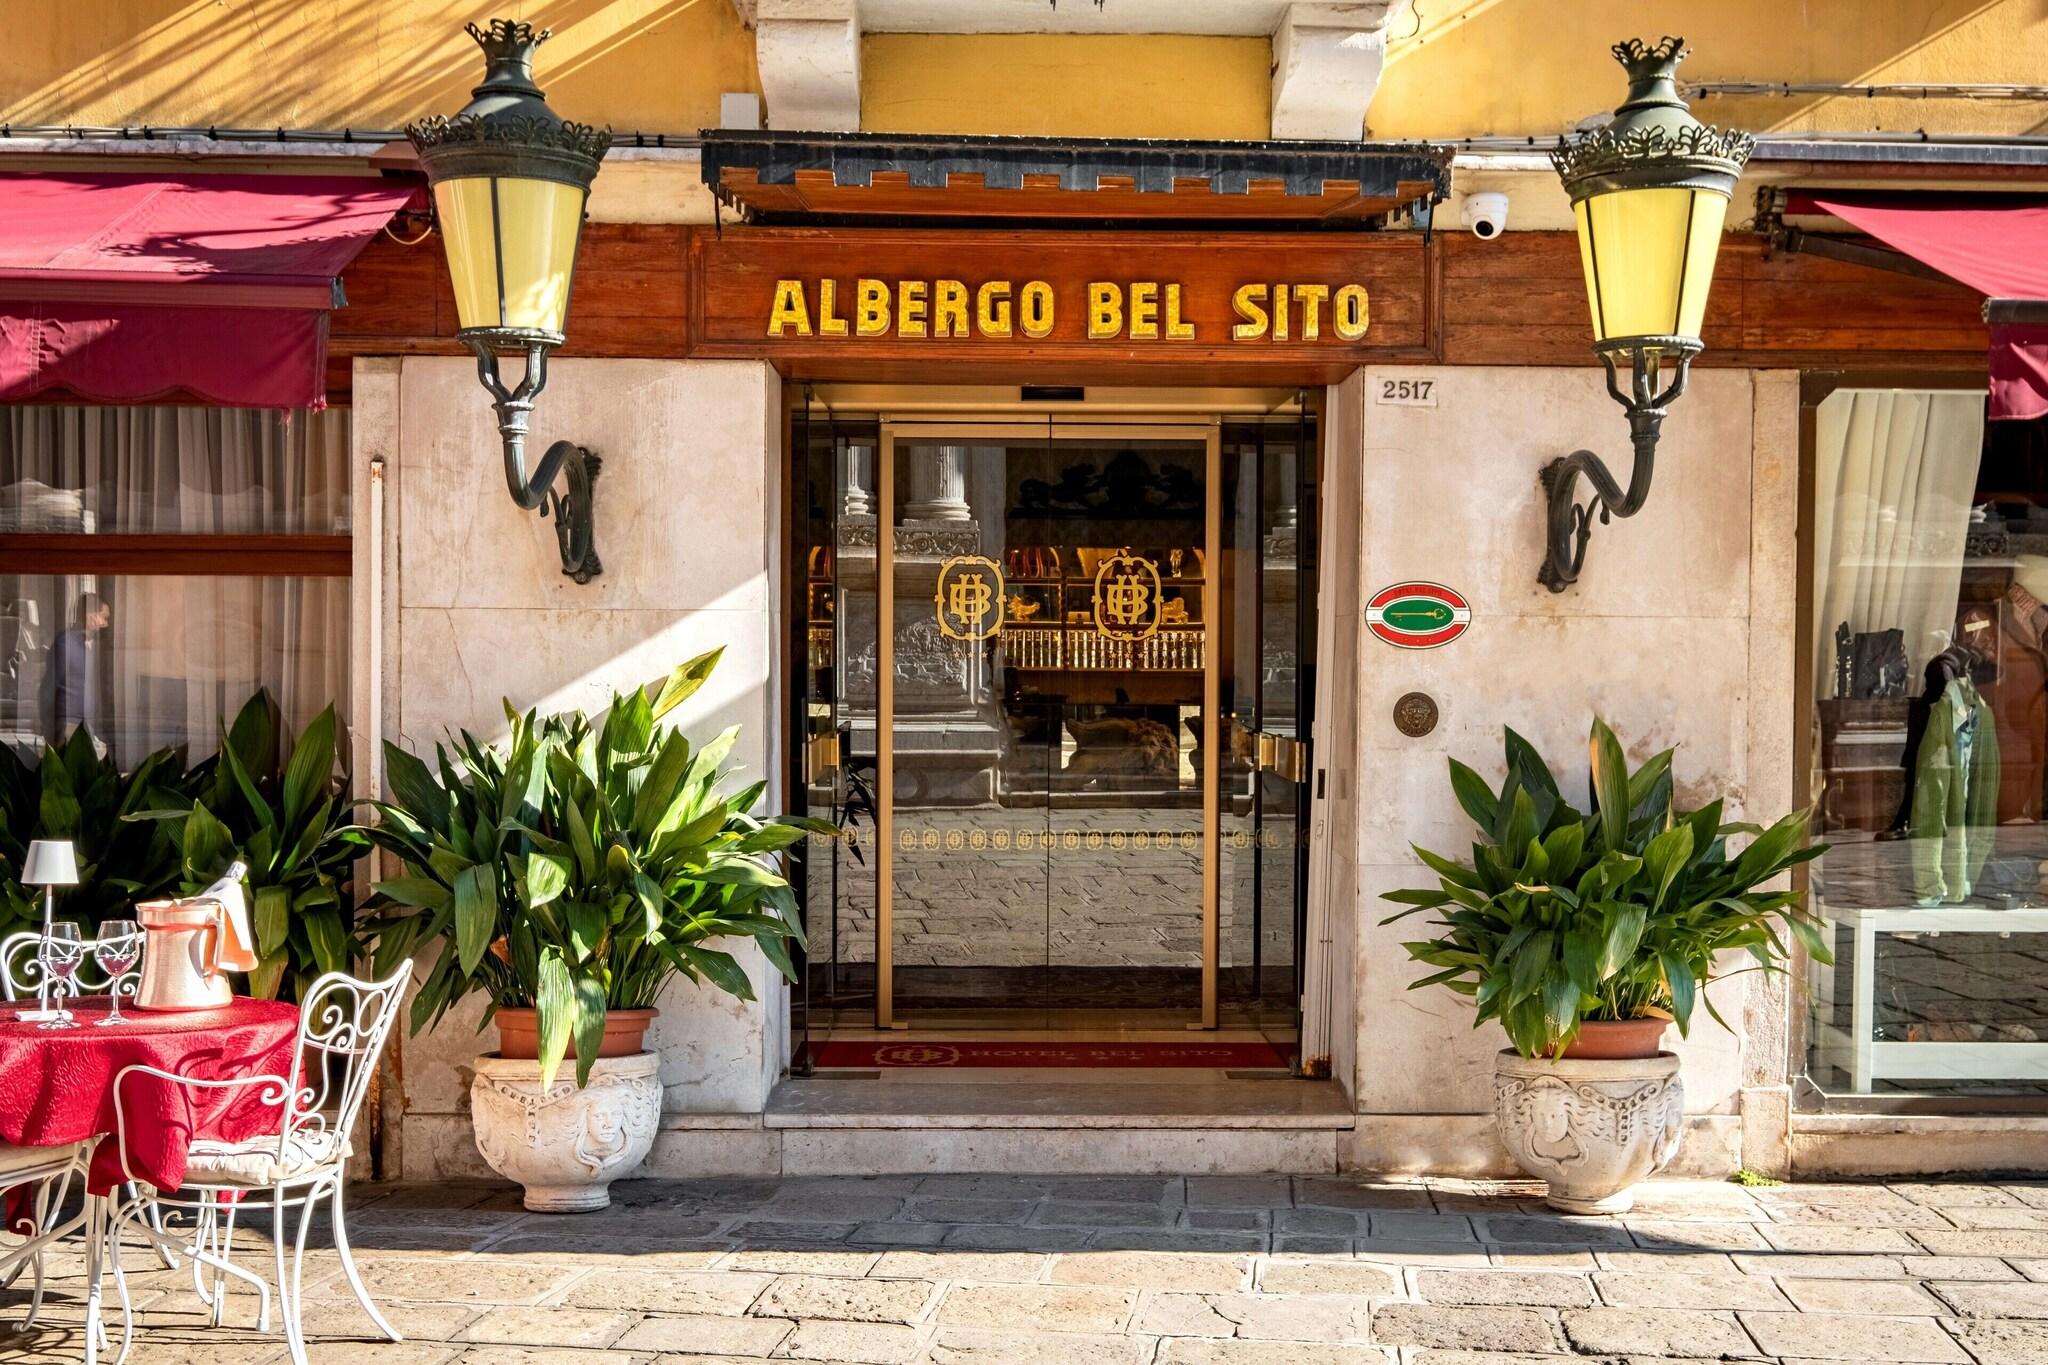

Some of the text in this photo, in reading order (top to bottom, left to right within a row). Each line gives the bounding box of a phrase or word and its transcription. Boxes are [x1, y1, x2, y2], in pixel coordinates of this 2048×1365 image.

[766, 278, 1370, 341] ALBERGO BEL SITO
[1383, 380, 1434, 400] 2517
